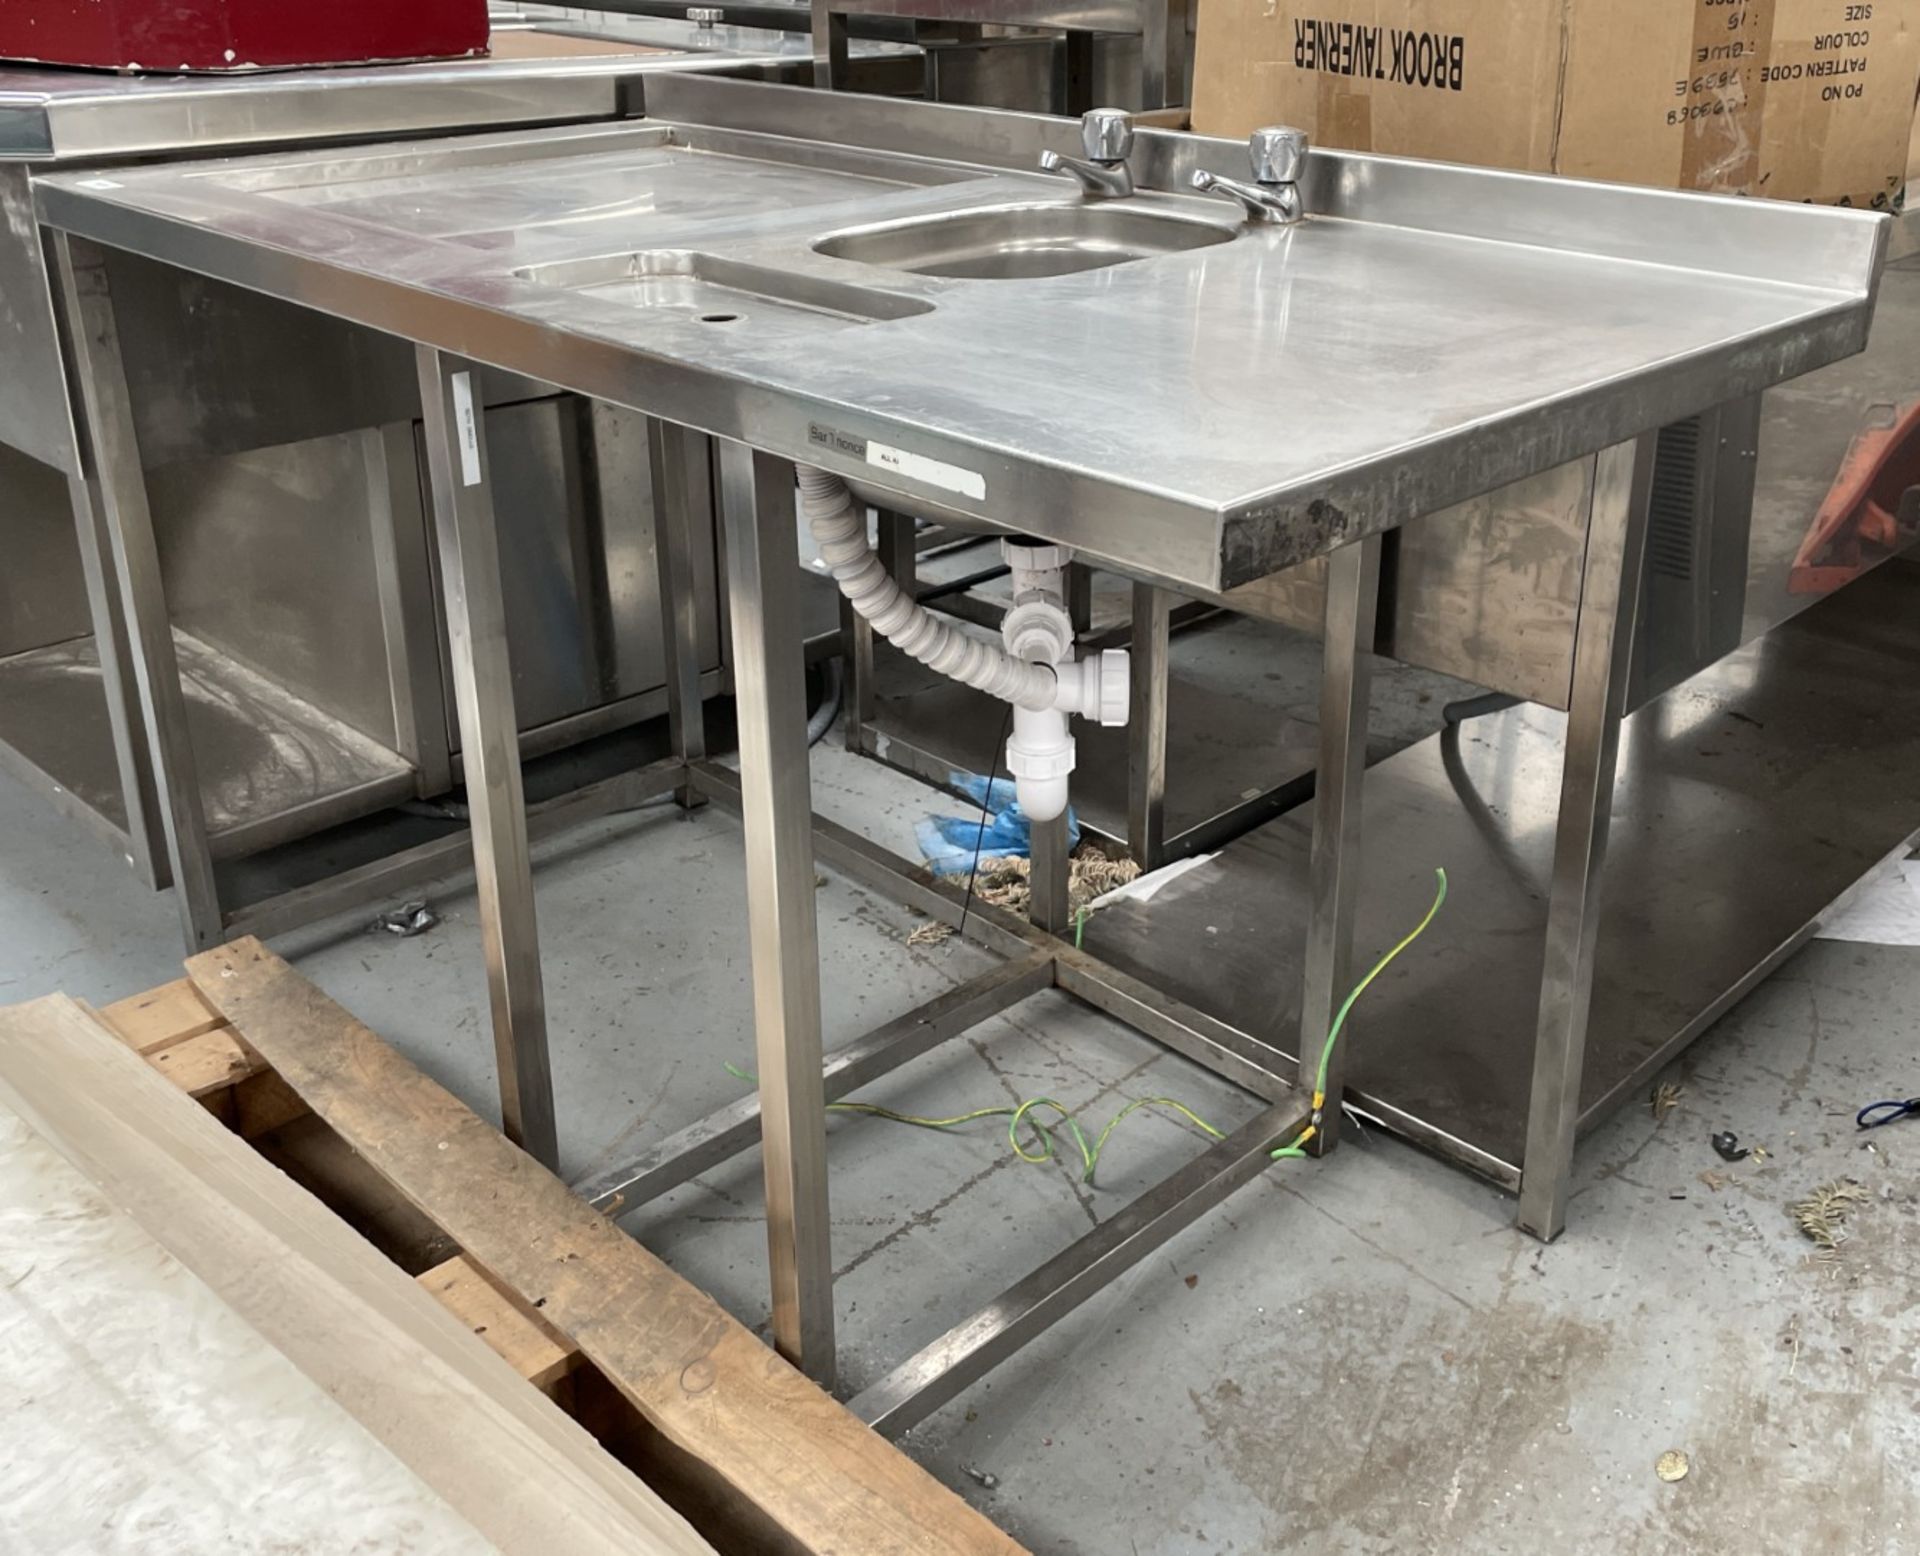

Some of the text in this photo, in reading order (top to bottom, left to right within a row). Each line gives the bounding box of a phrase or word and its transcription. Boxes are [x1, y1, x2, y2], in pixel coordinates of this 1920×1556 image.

[1845, 5, 1873, 21] SIZE
[1814, 31, 1869, 50] COLOUR
[1294, 18, 1464, 91] BROOK TAVERNER
[1760, 65, 1803, 83] CODE
[1806, 57, 1867, 77] PATTERN
[1821, 85, 1842, 102] NO
[1844, 82, 1863, 99] PO
